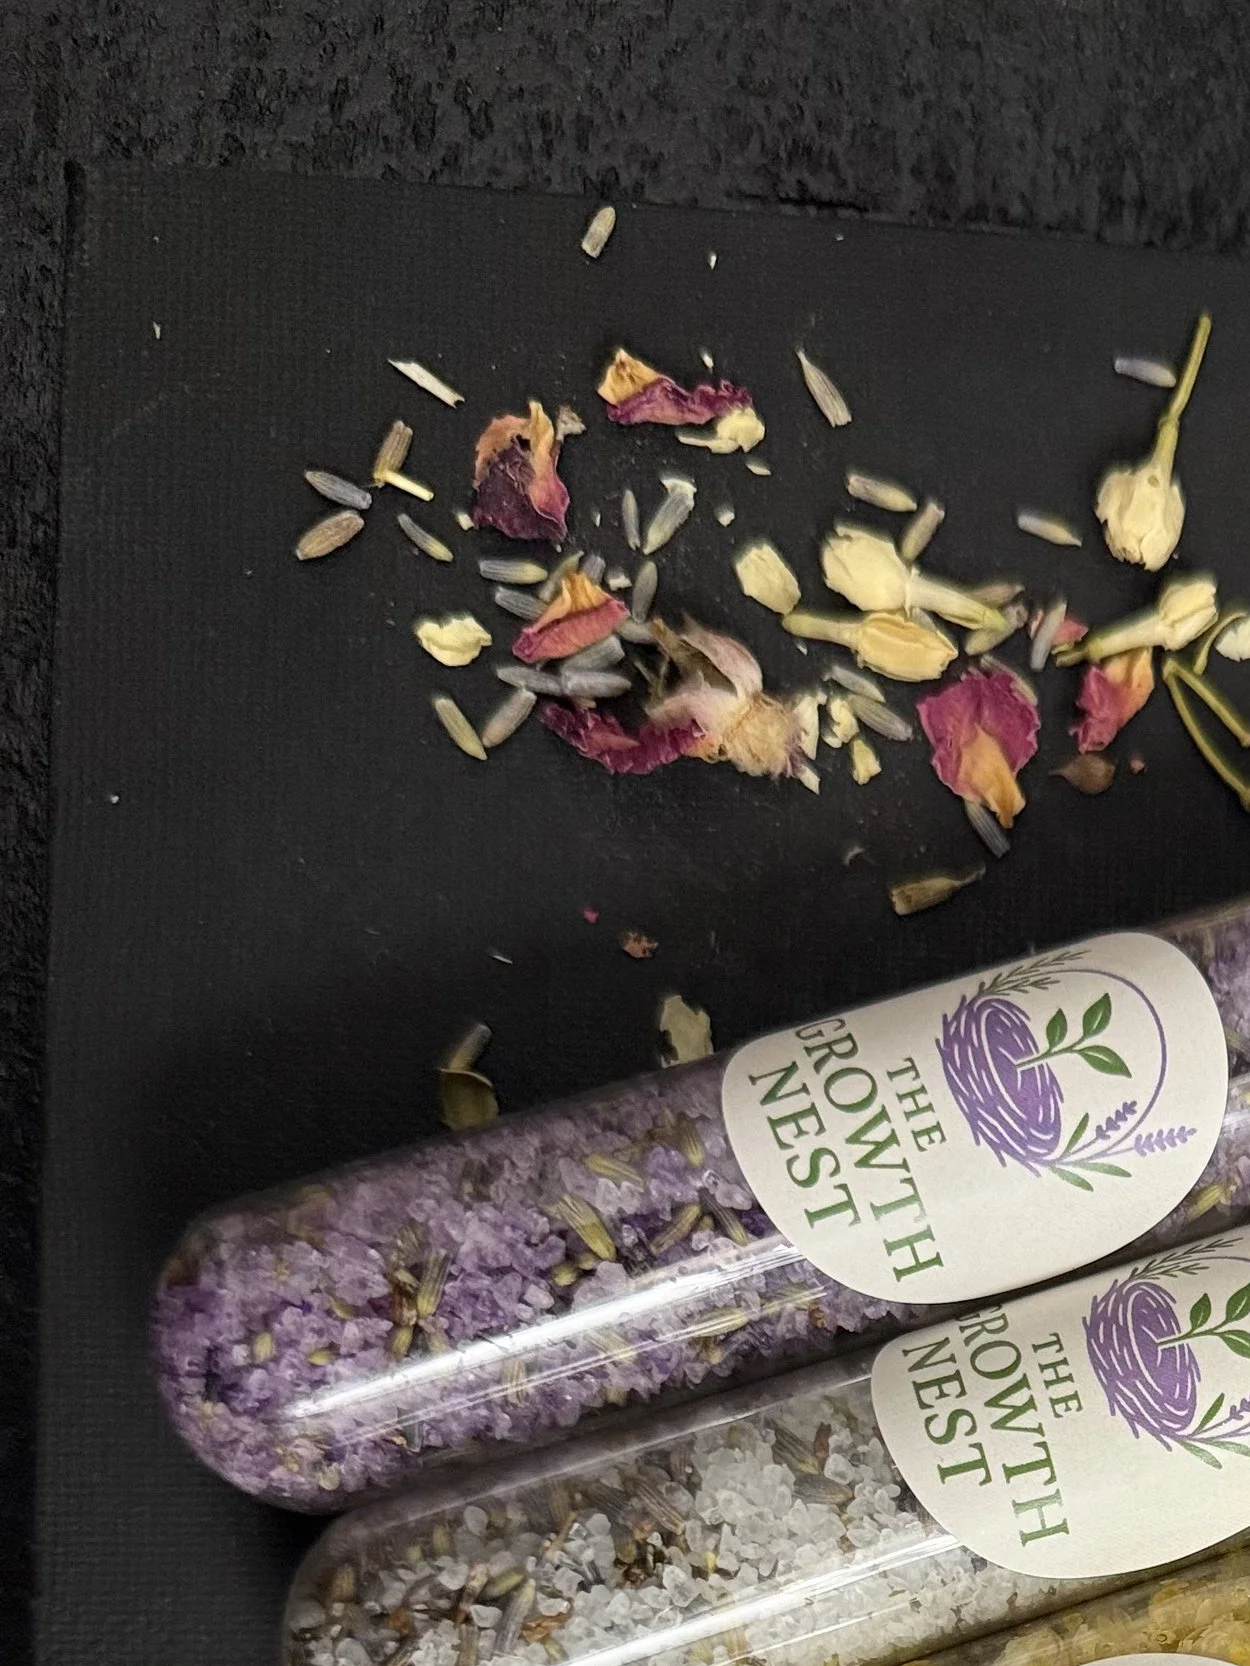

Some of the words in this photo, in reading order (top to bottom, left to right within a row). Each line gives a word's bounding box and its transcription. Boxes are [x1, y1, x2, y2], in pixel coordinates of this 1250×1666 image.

[748, 1060, 862, 1231] NEST
[795, 1017, 944, 1284] GROWTH
[886, 1057, 947, 1153] THE
[901, 1336, 992, 1488] NEST
[1031, 1332, 1083, 1419] THE
